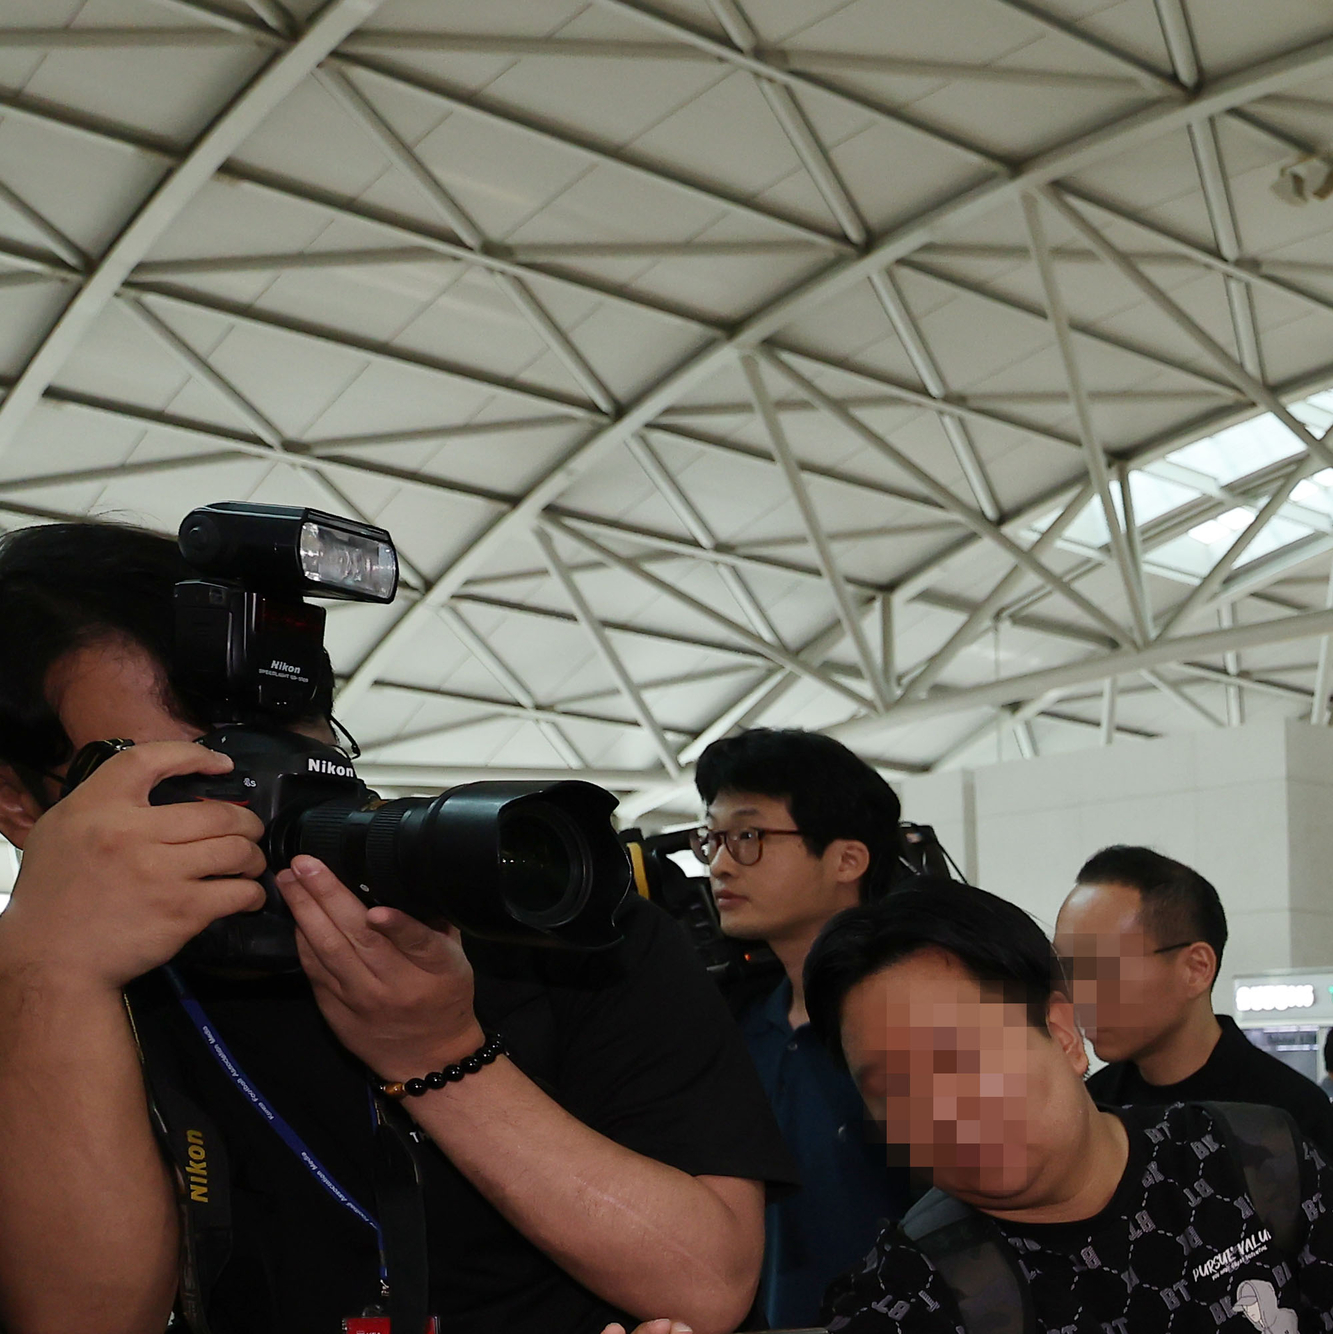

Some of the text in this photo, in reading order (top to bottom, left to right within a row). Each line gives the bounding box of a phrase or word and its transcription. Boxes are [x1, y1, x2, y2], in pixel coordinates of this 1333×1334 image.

[271, 660, 301, 674] Nikon
[308, 758, 354, 777] Nikon
[213, 1043, 240, 1078] Association
[236, 1078, 259, 1103] Football
[186, 1129, 209, 1203] Nikon
